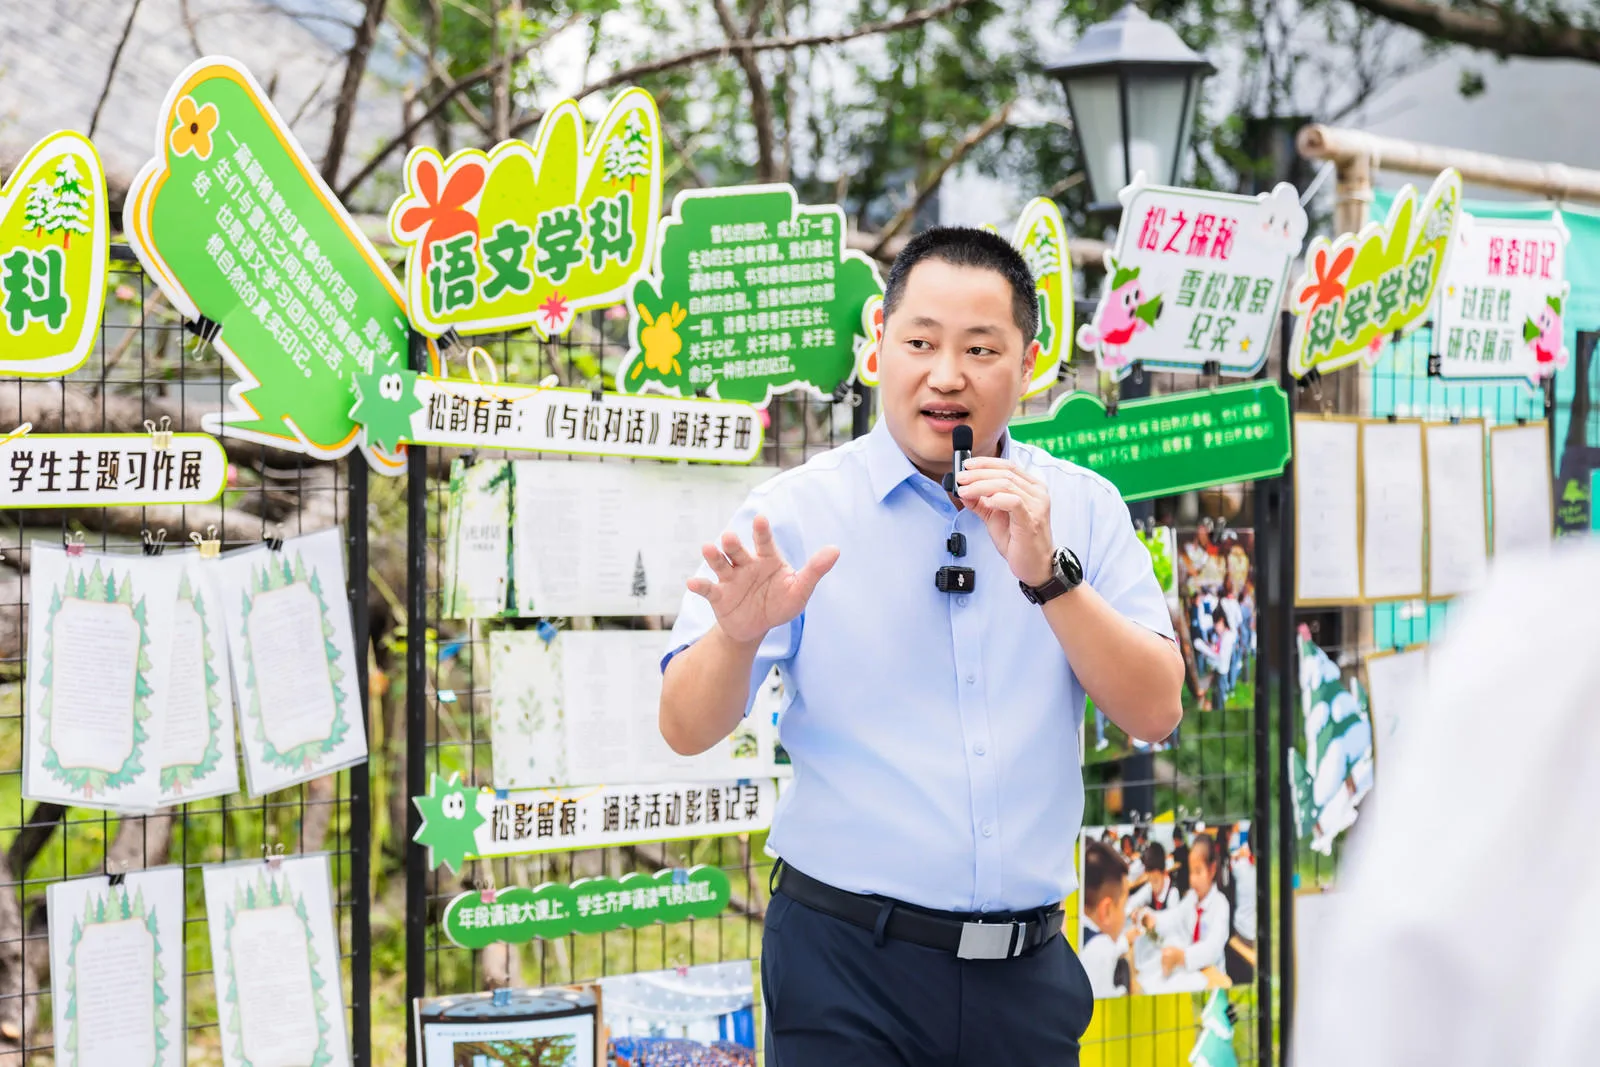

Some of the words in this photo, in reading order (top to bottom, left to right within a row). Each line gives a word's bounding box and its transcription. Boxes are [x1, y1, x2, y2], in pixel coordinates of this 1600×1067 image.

[1137, 206, 1239, 260] 松之探秘
[430, 193, 633, 316] 语文学科
[1489, 237, 1557, 279] 探索印记
[3, 249, 67, 330] 科
[1176, 271, 1275, 313] 雪松观察
[1308, 255, 1433, 356] 科学学科
[1463, 288, 1510, 323] 过程性
[1185, 319, 1237, 352] 纪实
[1448, 328, 1515, 362] 研究展示
[10, 451, 203, 491] 学生主题习作展
[492, 786, 759, 841] 松影留痕：诵读活动影像记录
